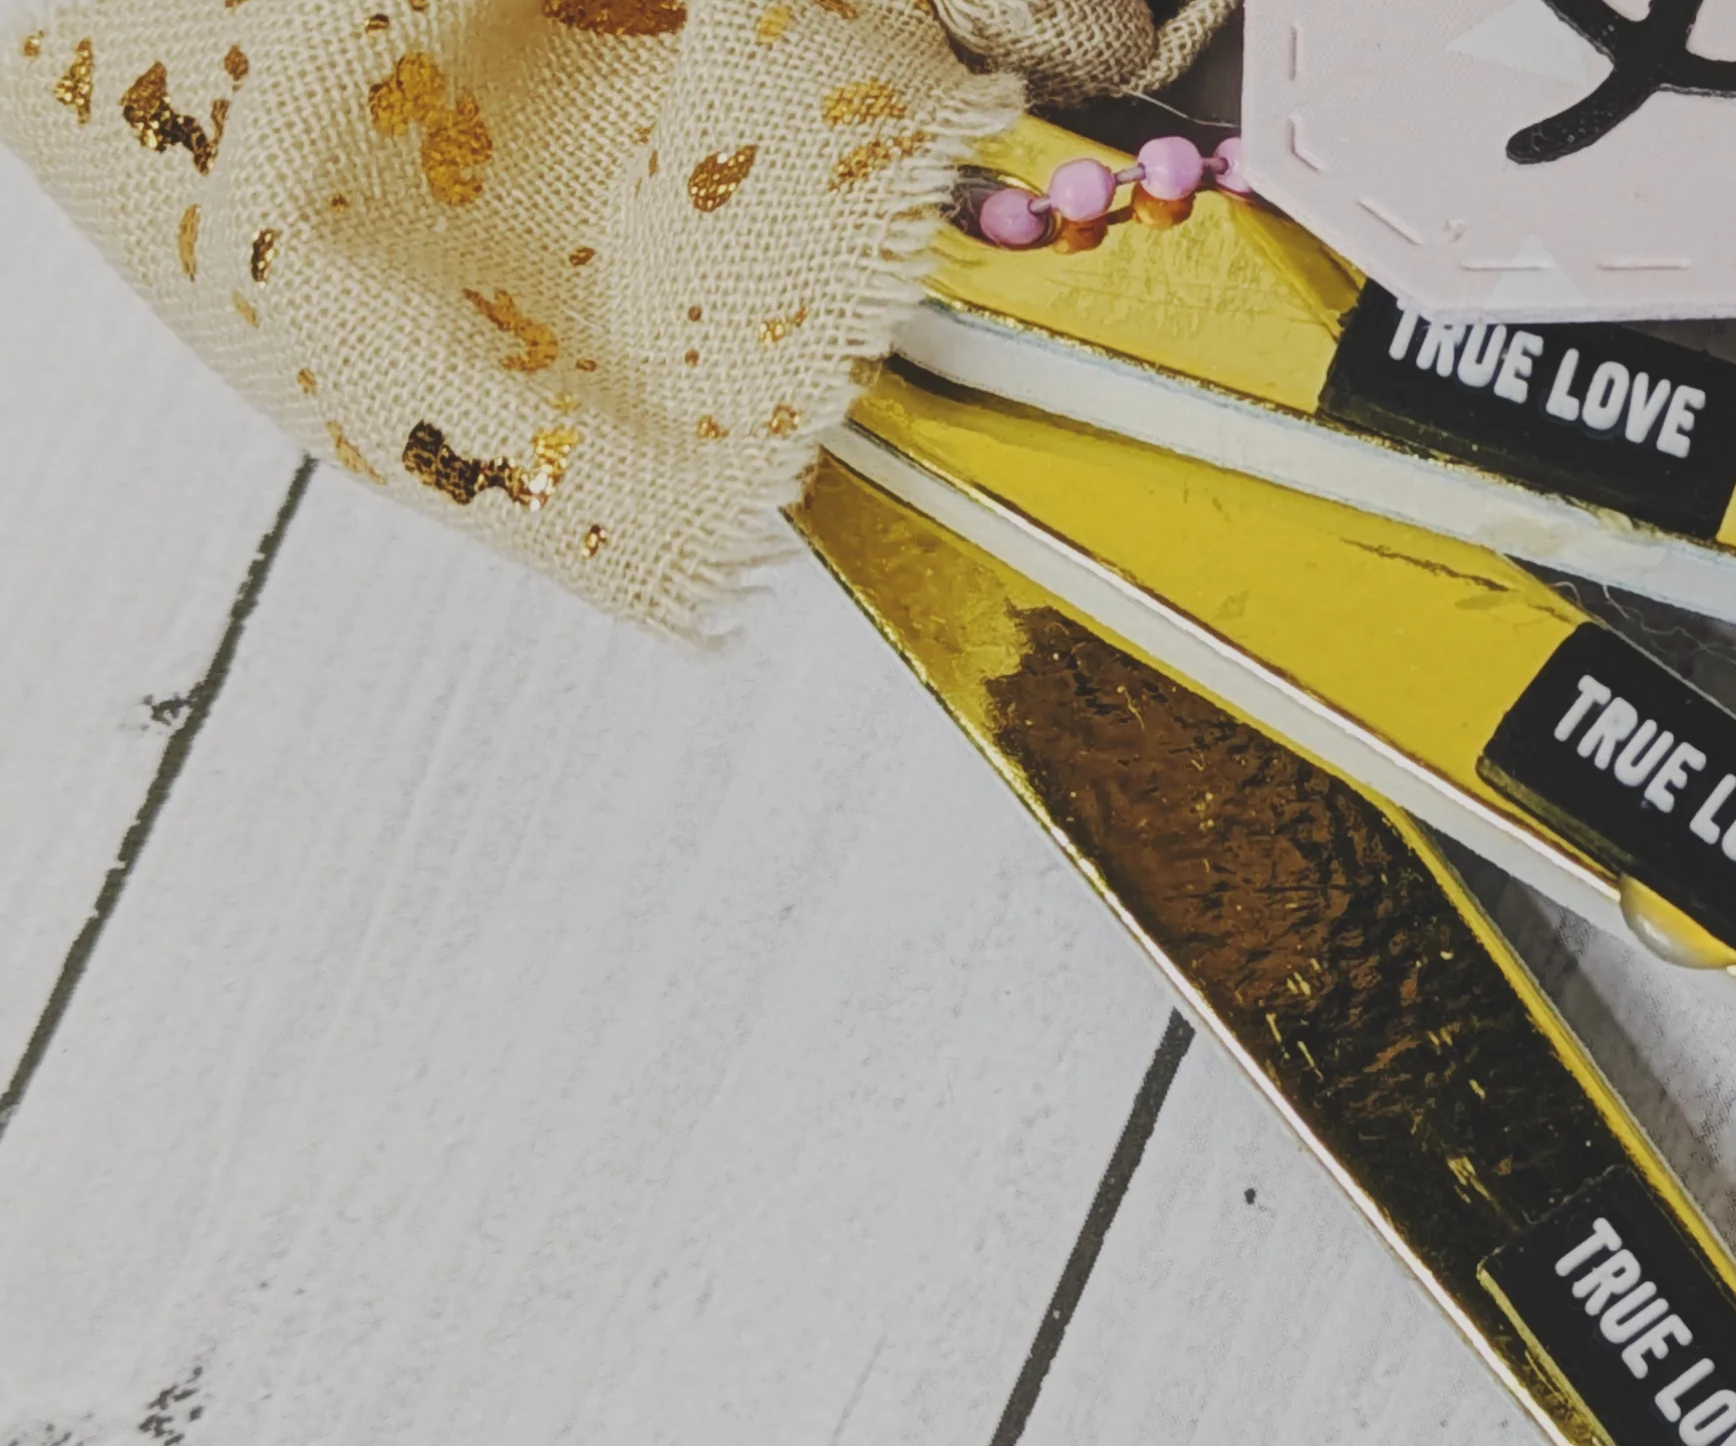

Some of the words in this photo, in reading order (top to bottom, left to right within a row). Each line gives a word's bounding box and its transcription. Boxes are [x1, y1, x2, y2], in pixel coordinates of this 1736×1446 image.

[1545, 348, 1706, 458] LOVE
[1554, 675, 1706, 812] TRUE
[1555, 1217, 1692, 1378] TRUE
